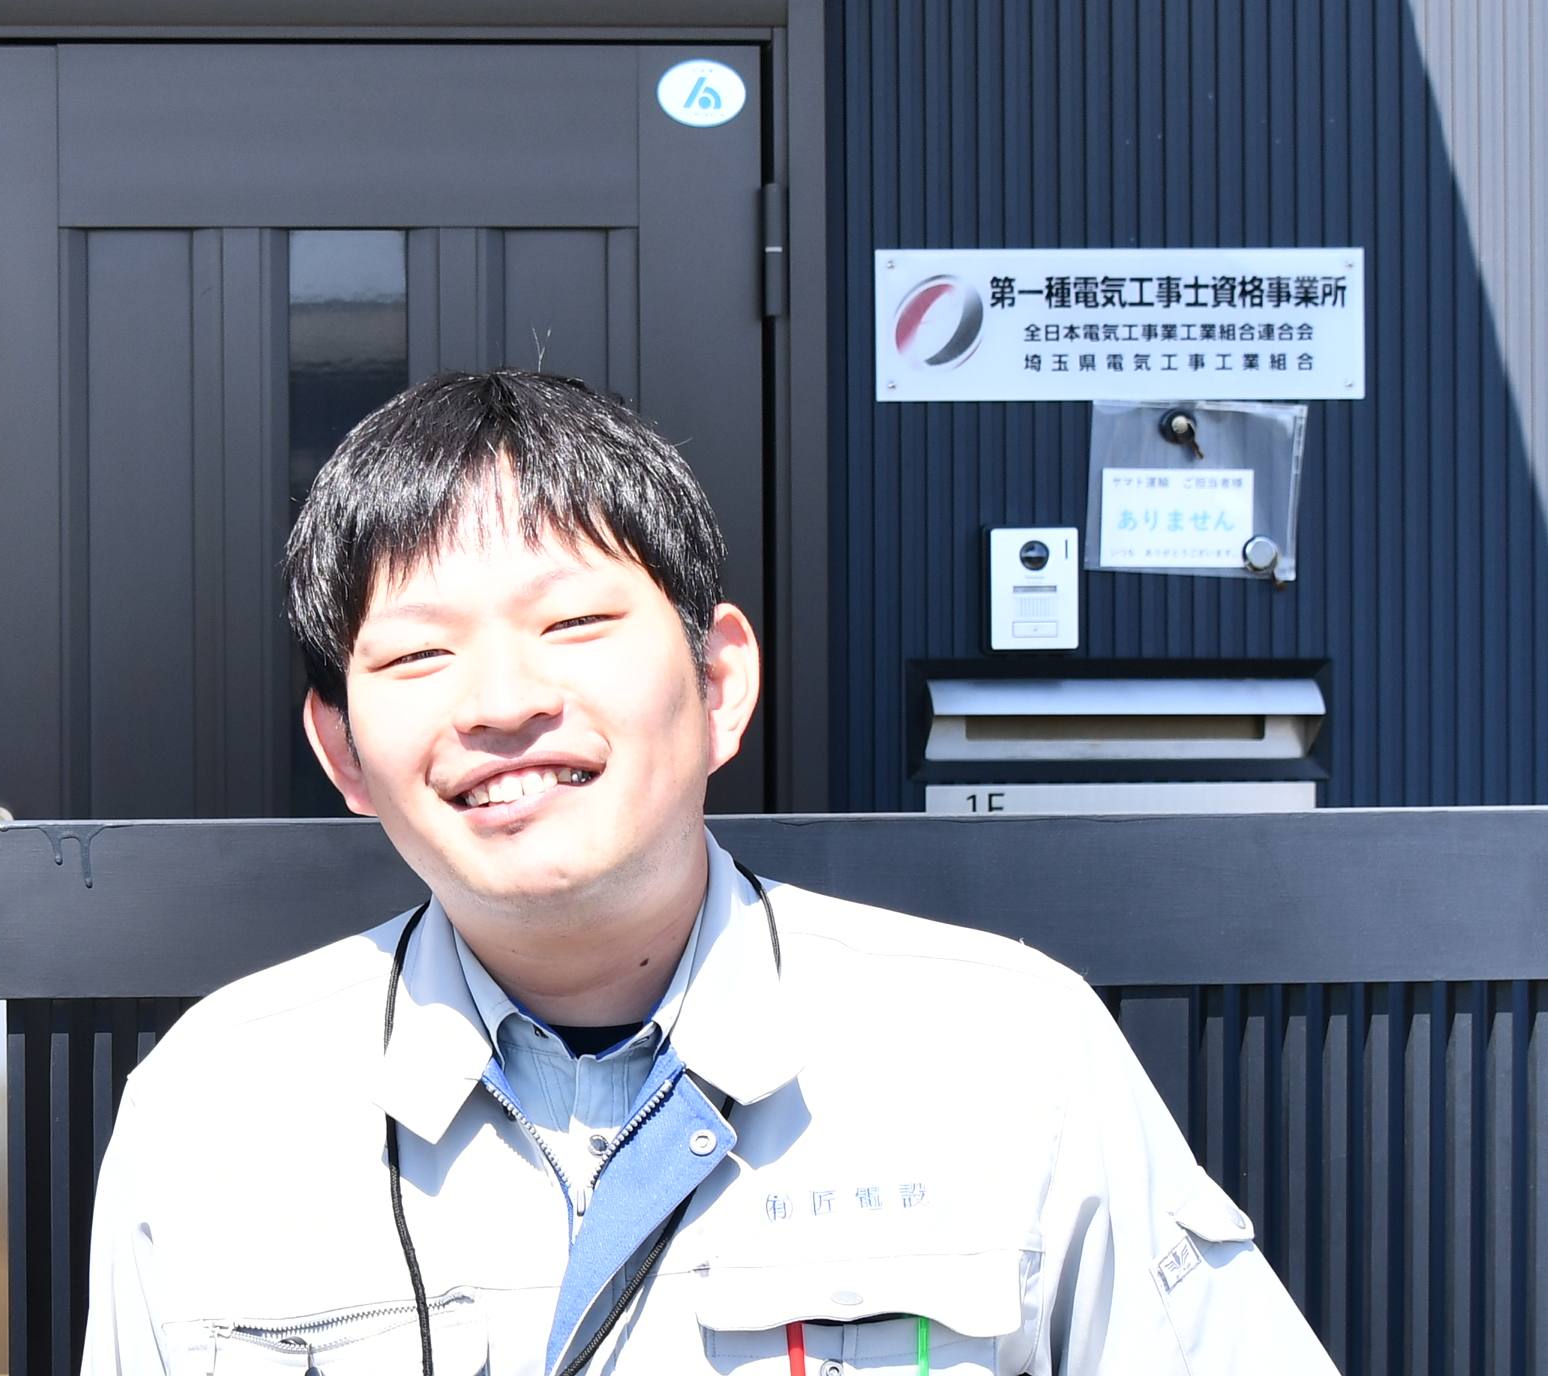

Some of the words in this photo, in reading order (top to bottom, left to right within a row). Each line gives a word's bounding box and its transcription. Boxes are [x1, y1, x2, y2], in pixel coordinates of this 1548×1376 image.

[989, 275, 1347, 309] 第一種電気工事士資格事業所
[1023, 323, 1314, 343] 全日本電気工事業工業組合連合会
[1023, 353, 1314, 372] 埼玉県電気工事工業組合
[1117, 509, 1236, 532] ありません
